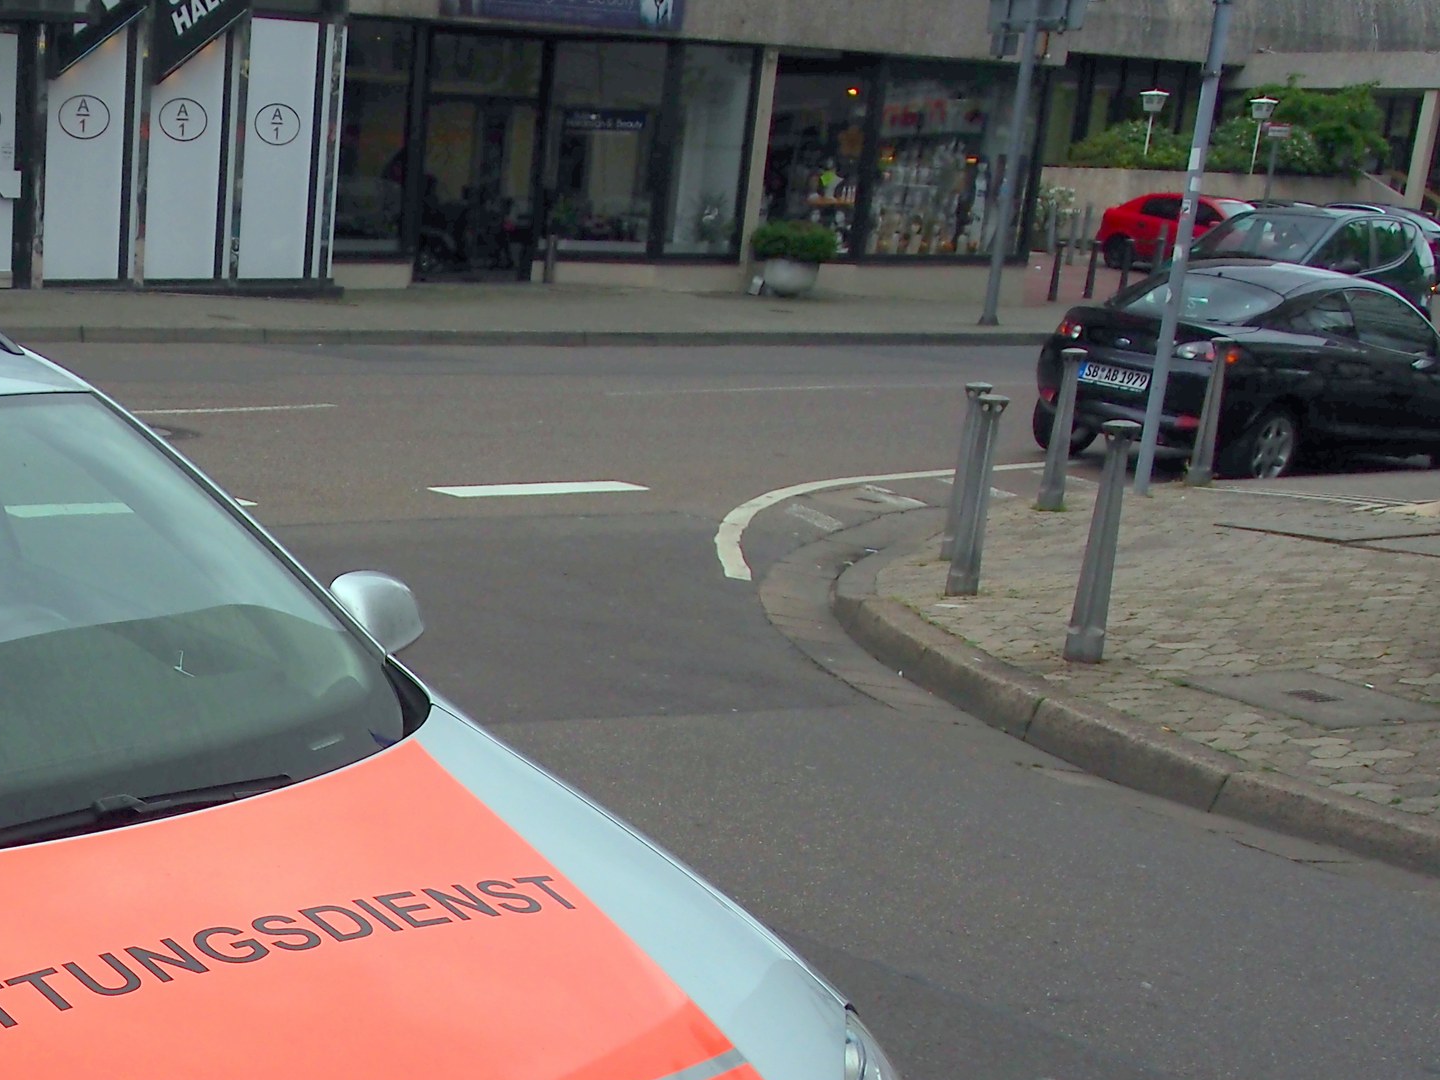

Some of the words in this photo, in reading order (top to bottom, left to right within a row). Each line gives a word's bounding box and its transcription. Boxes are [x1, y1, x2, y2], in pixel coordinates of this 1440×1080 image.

[77, 98, 89, 112] A
[177, 103, 189, 117] A
[272, 108, 283, 121] A
[79, 119, 86, 133] 1
[179, 123, 185, 136] 1
[273, 127, 279, 140] 1
[1085, 364, 1100, 378] SB
[1104, 367, 1120, 382] AB
[1118, 370, 1148, 387] 1979
